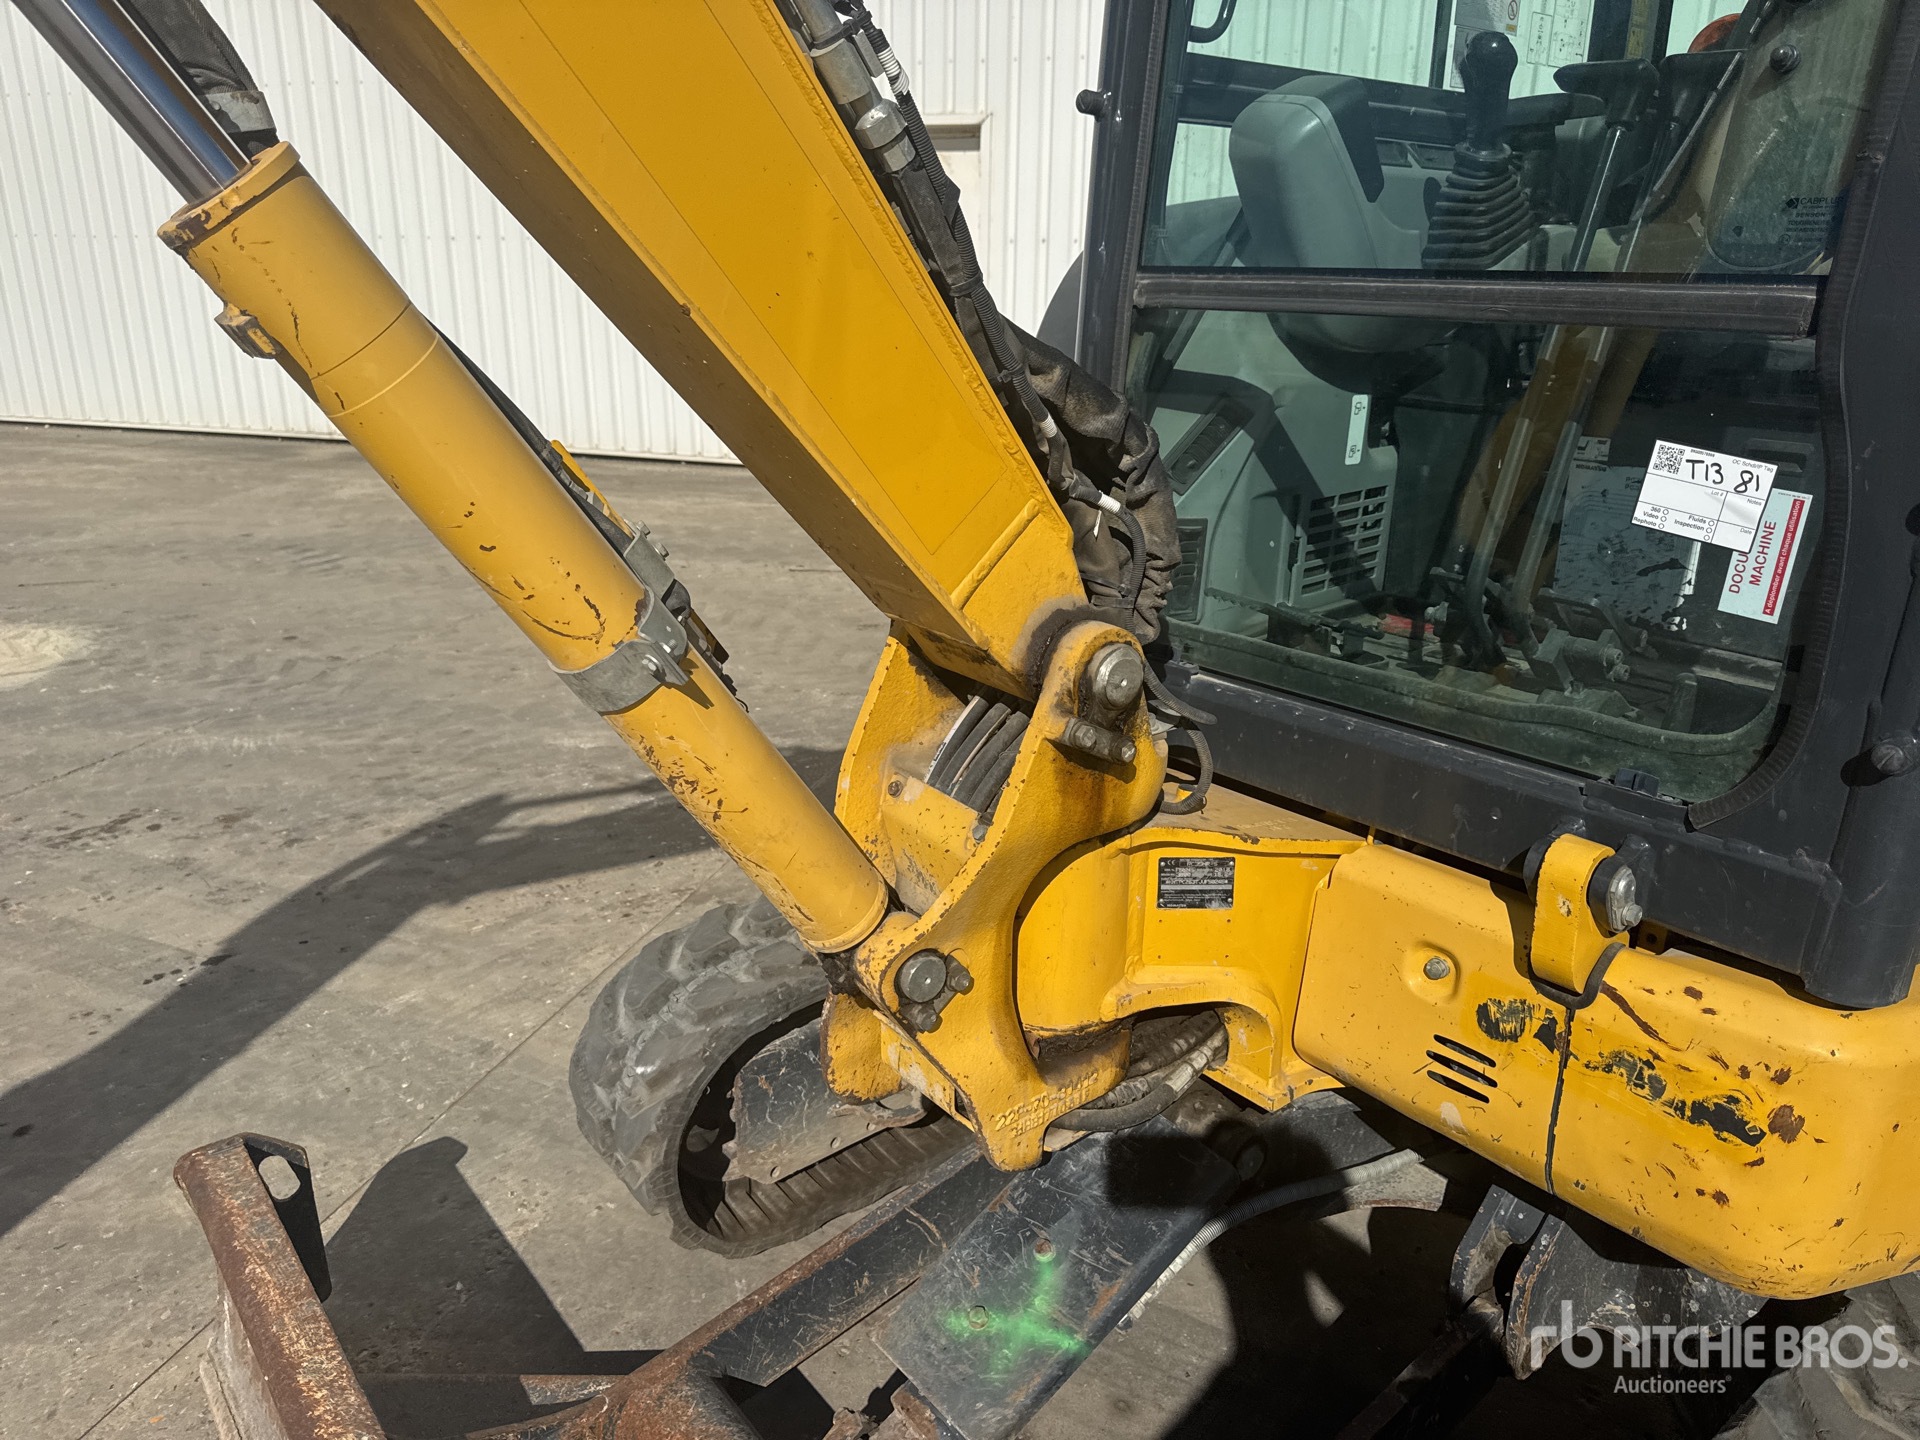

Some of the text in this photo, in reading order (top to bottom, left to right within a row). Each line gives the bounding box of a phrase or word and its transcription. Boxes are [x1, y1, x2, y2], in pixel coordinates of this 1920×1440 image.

[1747, 498, 1762, 506] Notes
[1633, 516, 1657, 527] Rephoto
[1643, 511, 1659, 520] Video
[1688, 515, 1707, 524] Fluids
[1789, 500, 1801, 532] utilisation
[1674, 519, 1705, 531] Inspection
[1781, 533, 1792, 556] chaque
[1748, 520, 1777, 586] MACHINE
[1777, 556, 1786, 574] avant
[1728, 553, 1749, 594] DOCU
